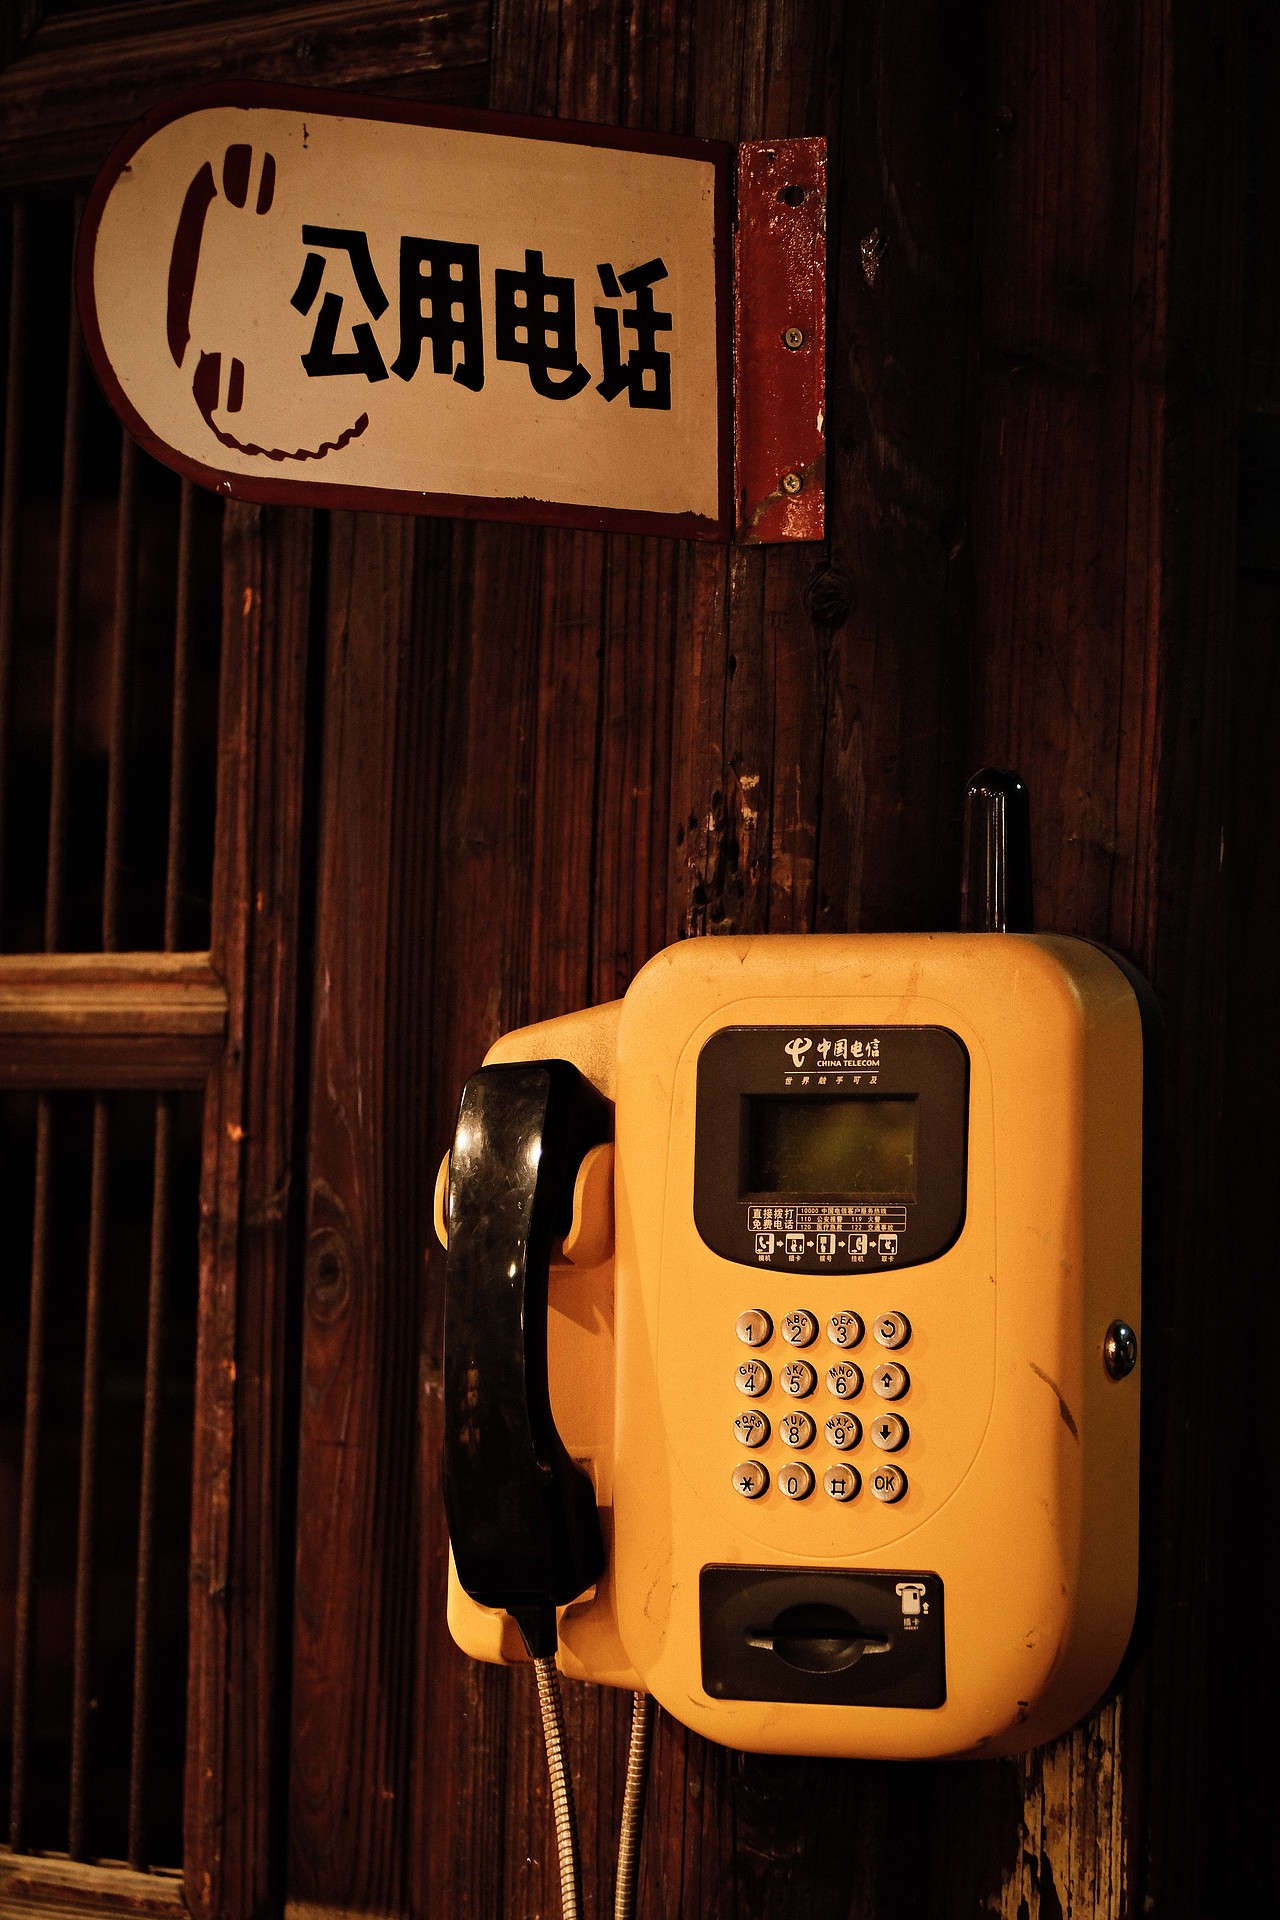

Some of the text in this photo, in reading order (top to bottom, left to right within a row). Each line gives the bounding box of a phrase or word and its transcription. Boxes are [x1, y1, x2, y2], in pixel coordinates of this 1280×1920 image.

[290, 224, 673, 411] 公用电话
[817, 1038, 880, 1060] 中国电信
[752, 1208, 794, 1219] 直接拨打
[752, 1219, 794, 1230] 免费电话
[786, 1314, 808, 1326] ABC
[831, 1315, 854, 1326] DEF
[745, 1324, 752, 1341] 1
[790, 1325, 801, 1342] 2
[836, 1326, 847, 1343] 3
[739, 1364, 759, 1375] GHI
[786, 1365, 804, 1376] JKL
[828, 1366, 853, 1378] MNO
[744, 1374, 755, 1392] 4
[789, 1375, 800, 1393] 5
[835, 1376, 847, 1394] 6
[734, 1415, 762, 1428] PQRS
[782, 1415, 806, 1427] TUV
[825, 1417, 855, 1432] WXYZ
[743, 1425, 754, 1442] 7
[788, 1426, 800, 1444] 8
[834, 1427, 846, 1445] 9
[787, 1477, 798, 1495] 0
[874, 1475, 895, 1492] OK
